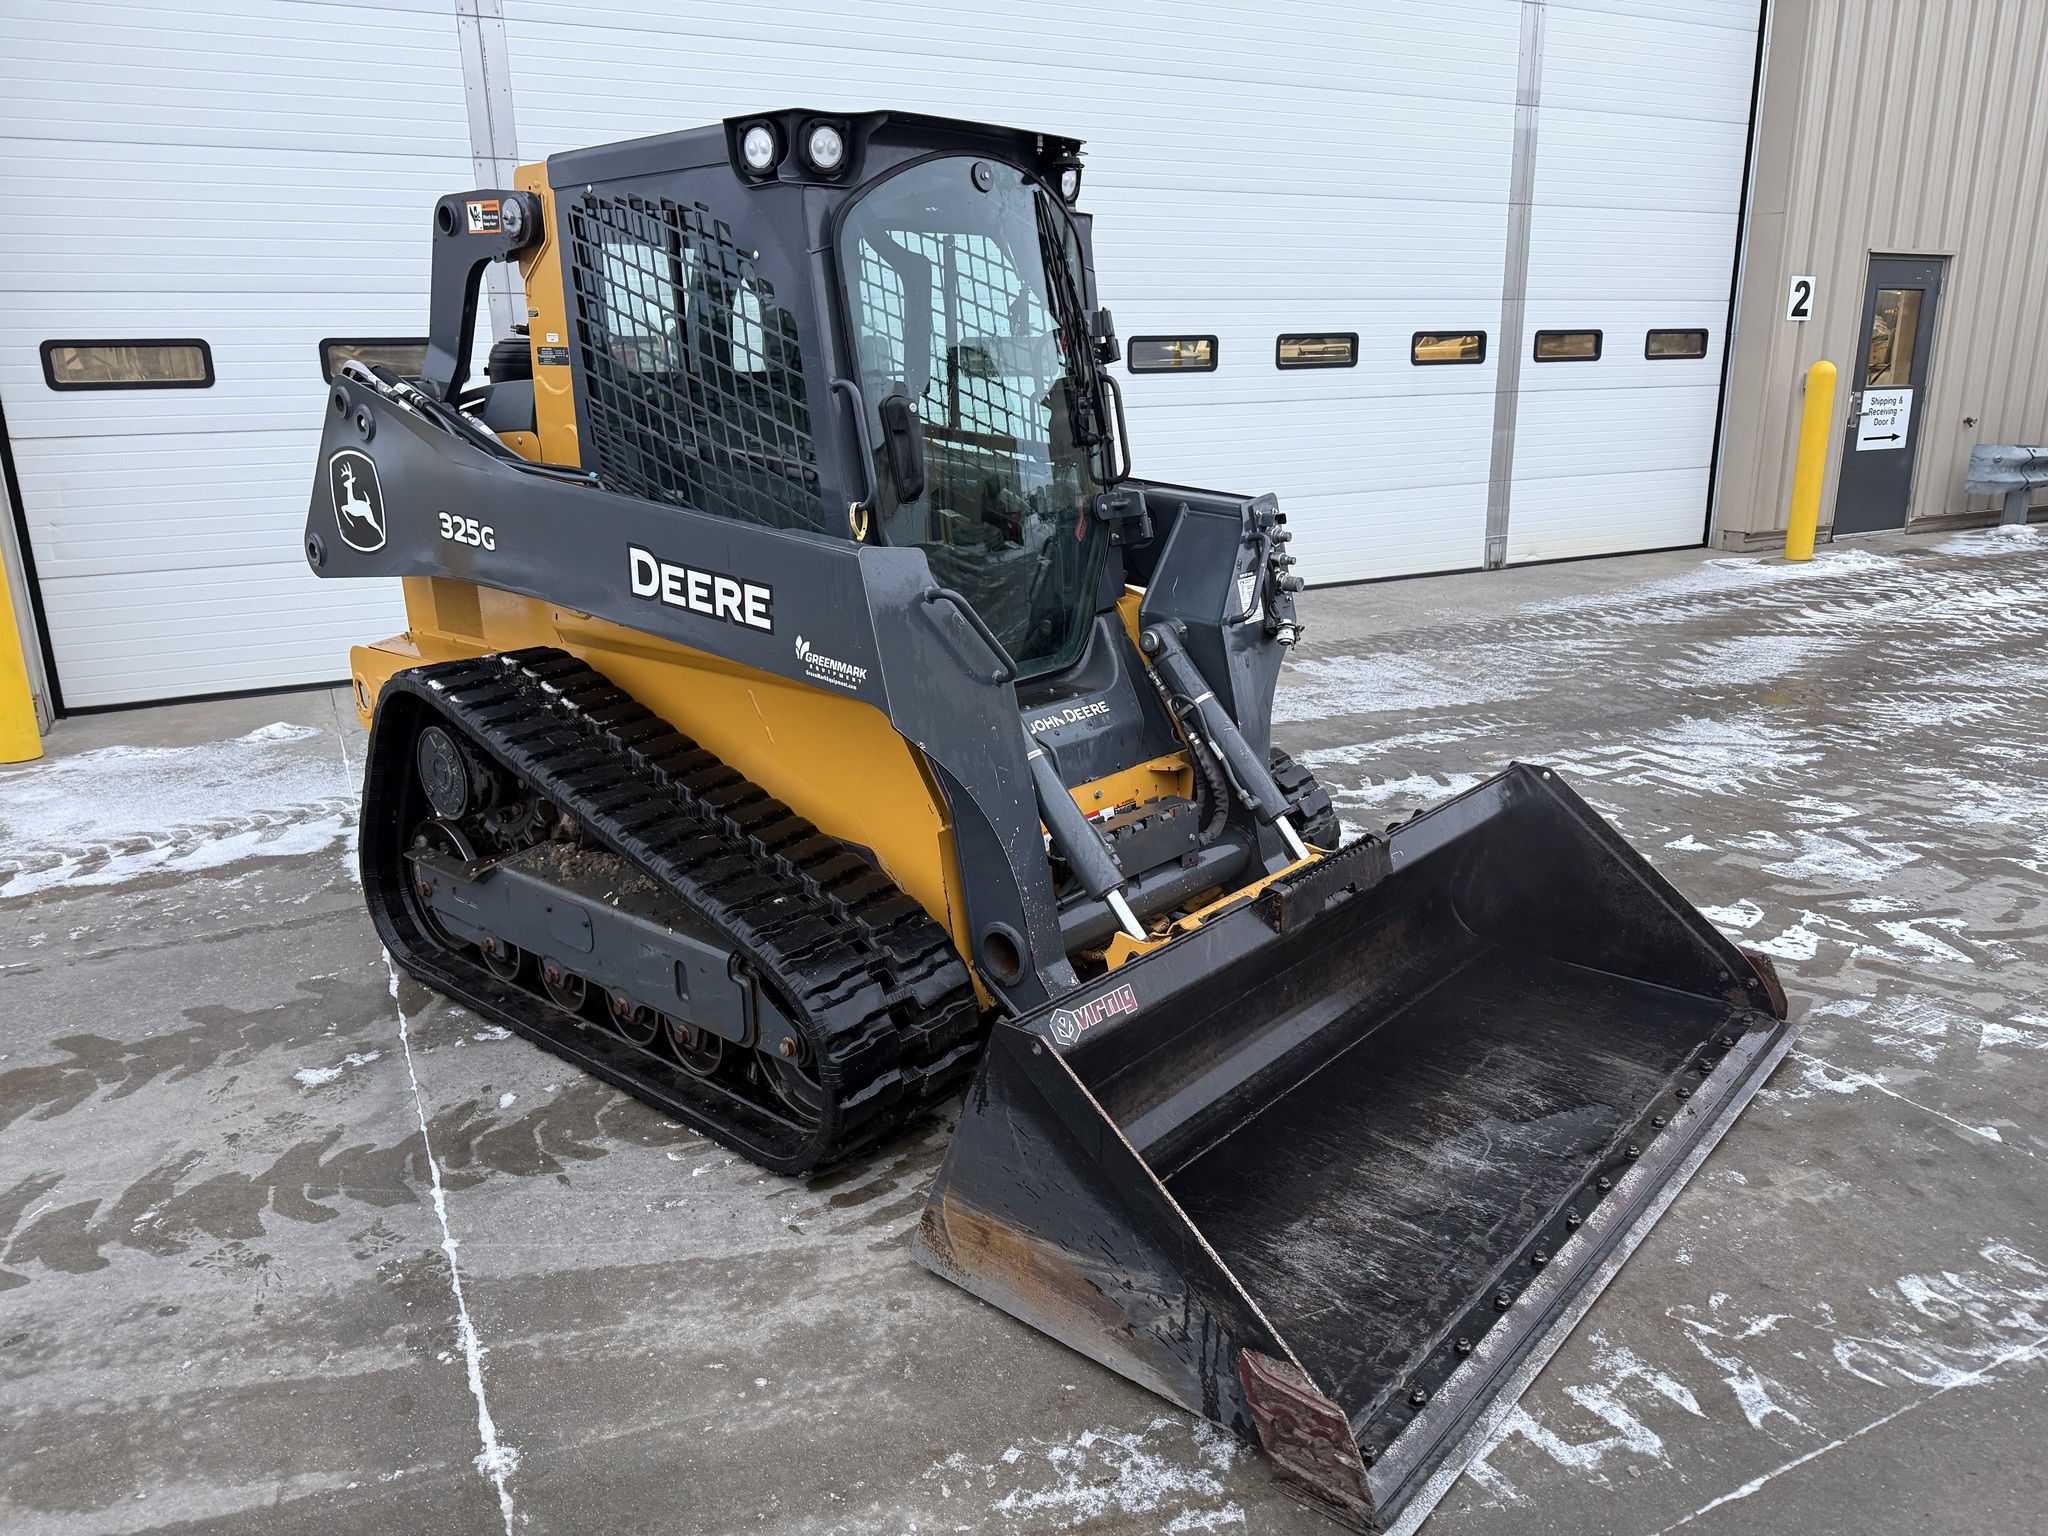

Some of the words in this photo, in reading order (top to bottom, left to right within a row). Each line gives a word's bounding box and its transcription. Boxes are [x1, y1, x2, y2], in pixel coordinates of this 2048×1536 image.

[1791, 281, 1811, 316] 2
[1869, 407, 1897, 416] Receiving
[1871, 396, 1897, 406] Shipping
[1874, 418, 1888, 426] Door
[439, 512, 495, 551] 325G
[629, 547, 771, 630] DEERE
[805, 652, 867, 680] GREENMARK
[809, 664, 861, 684] EQUIPMENT
[1030, 715, 1066, 735] JOHN
[1061, 700, 1110, 723] DEERE
